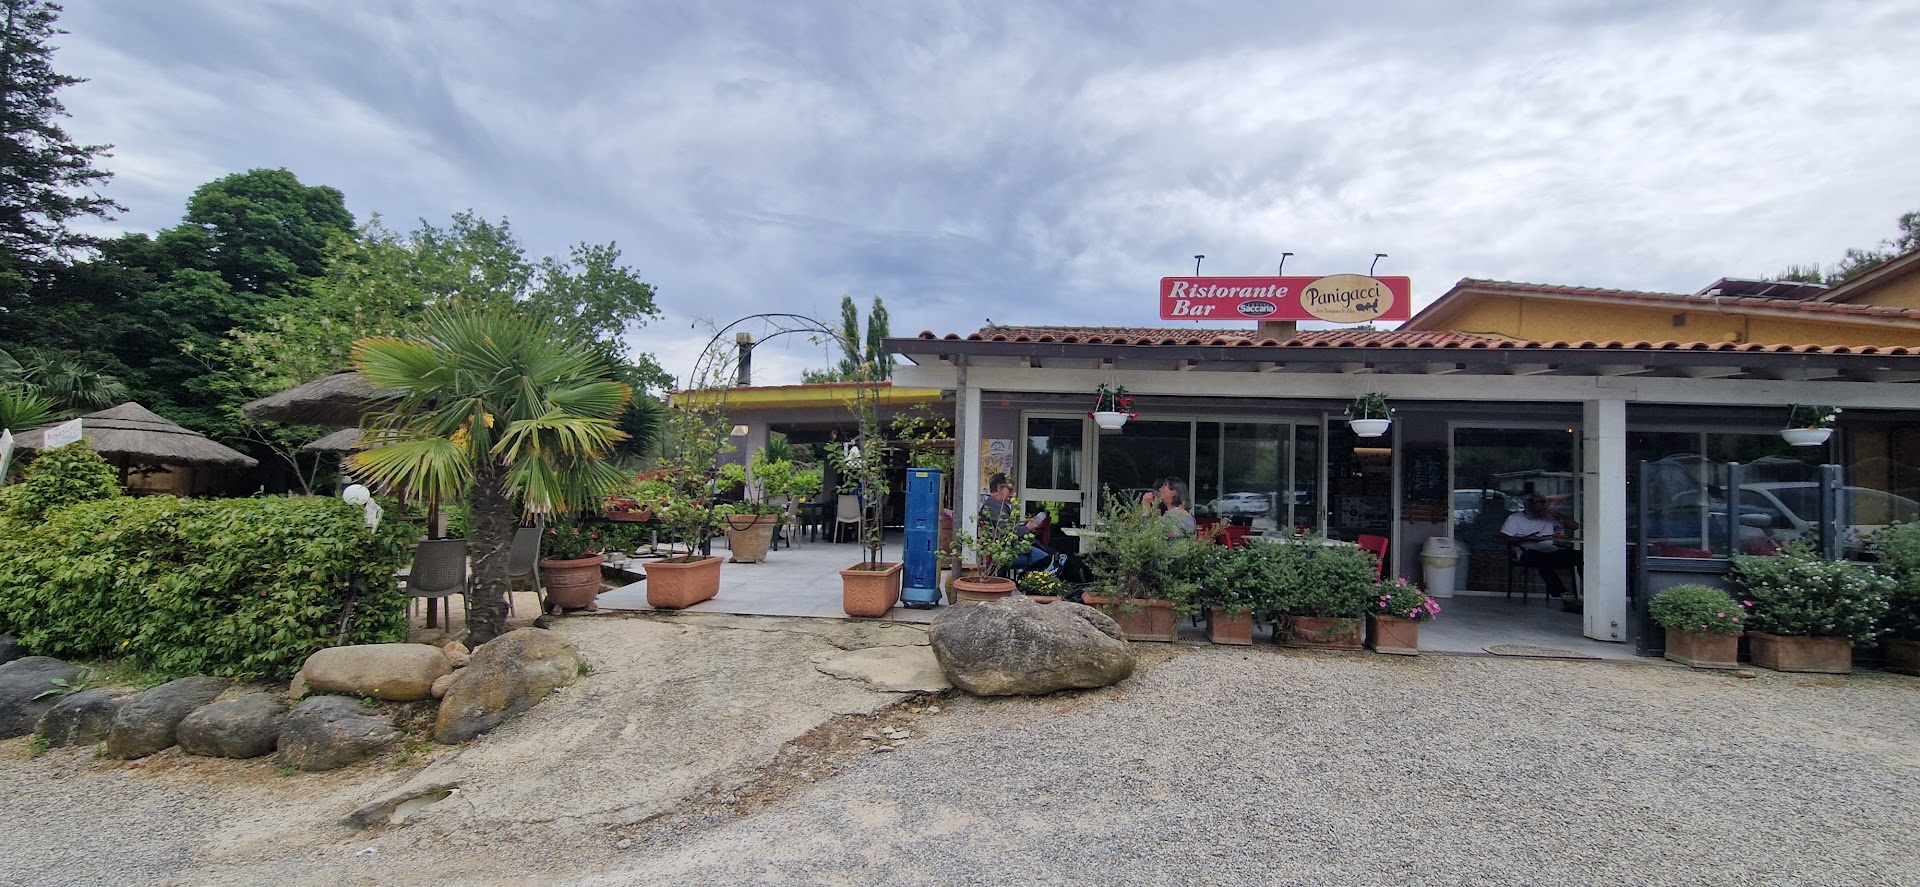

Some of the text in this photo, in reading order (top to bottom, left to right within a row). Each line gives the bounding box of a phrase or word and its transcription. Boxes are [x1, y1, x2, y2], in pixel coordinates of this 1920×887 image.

[1168, 281, 1288, 298] Ristorante
[1306, 283, 1380, 308] Panigacci
[1171, 300, 1216, 316] Bar
